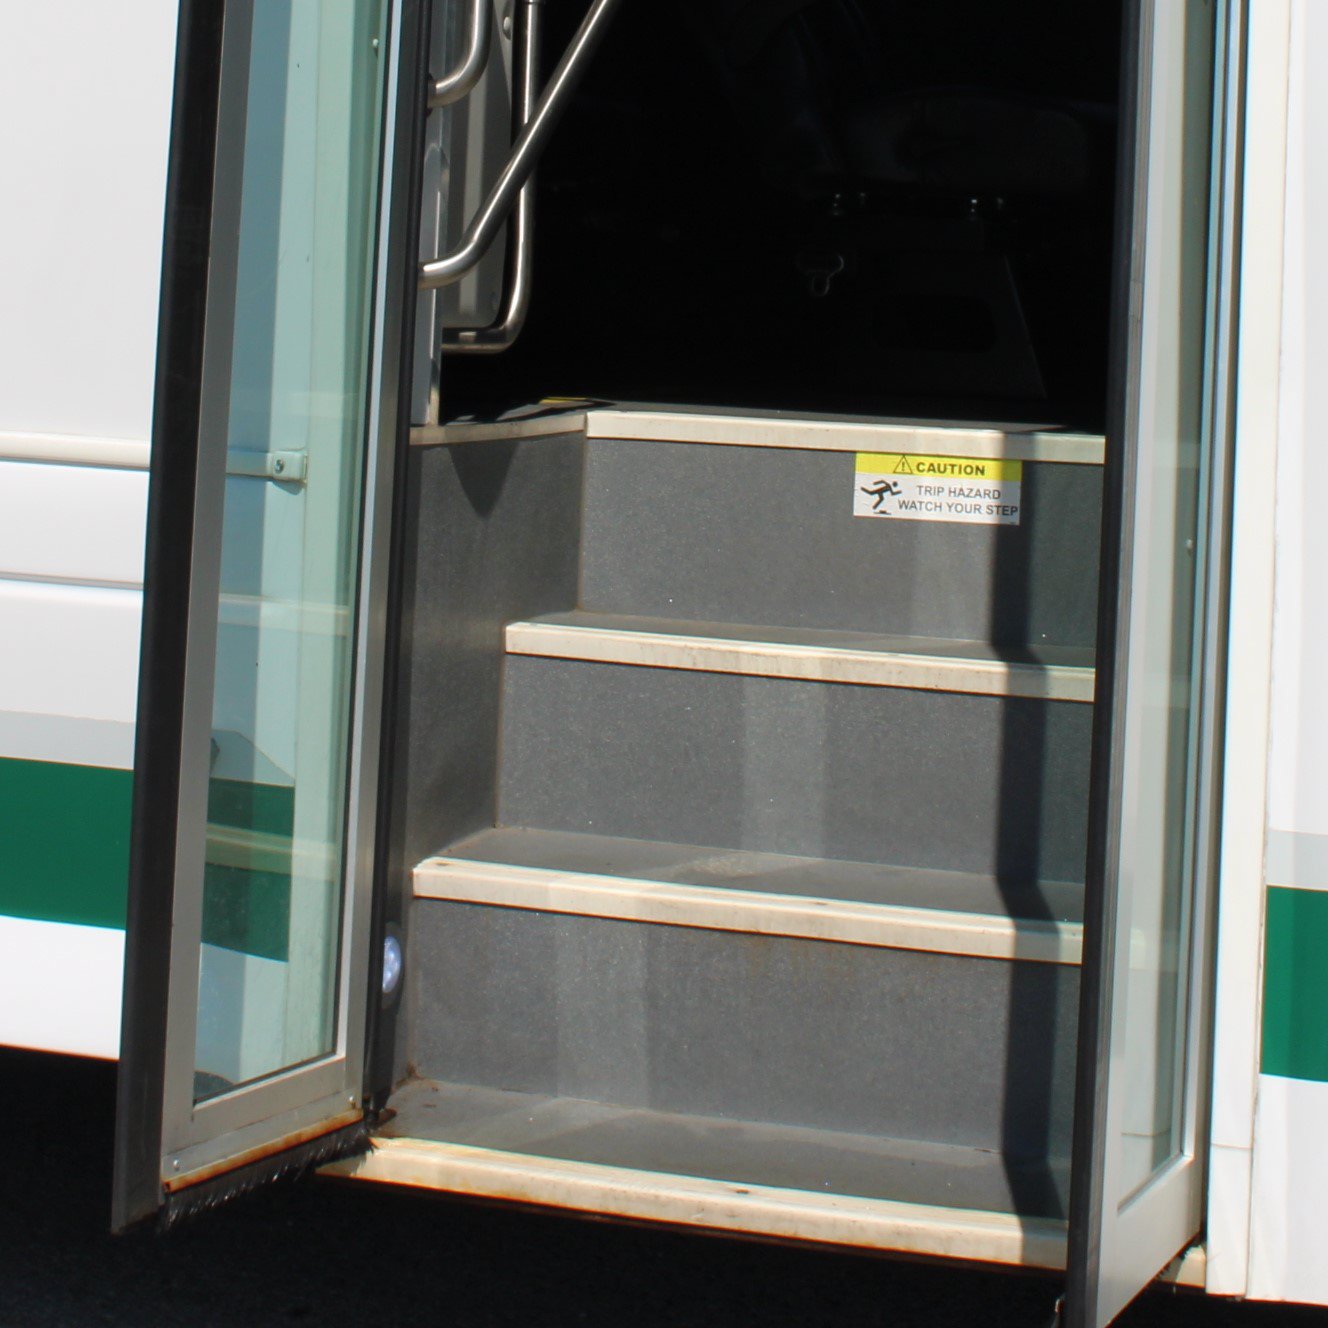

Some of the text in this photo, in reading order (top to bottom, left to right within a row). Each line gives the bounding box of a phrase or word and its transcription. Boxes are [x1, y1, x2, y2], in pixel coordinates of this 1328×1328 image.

[916, 462, 986, 476] CAUTION
[916, 485, 1001, 500] TRIP HAZARD
[898, 500, 1018, 517] WATCH YOUR STEP
